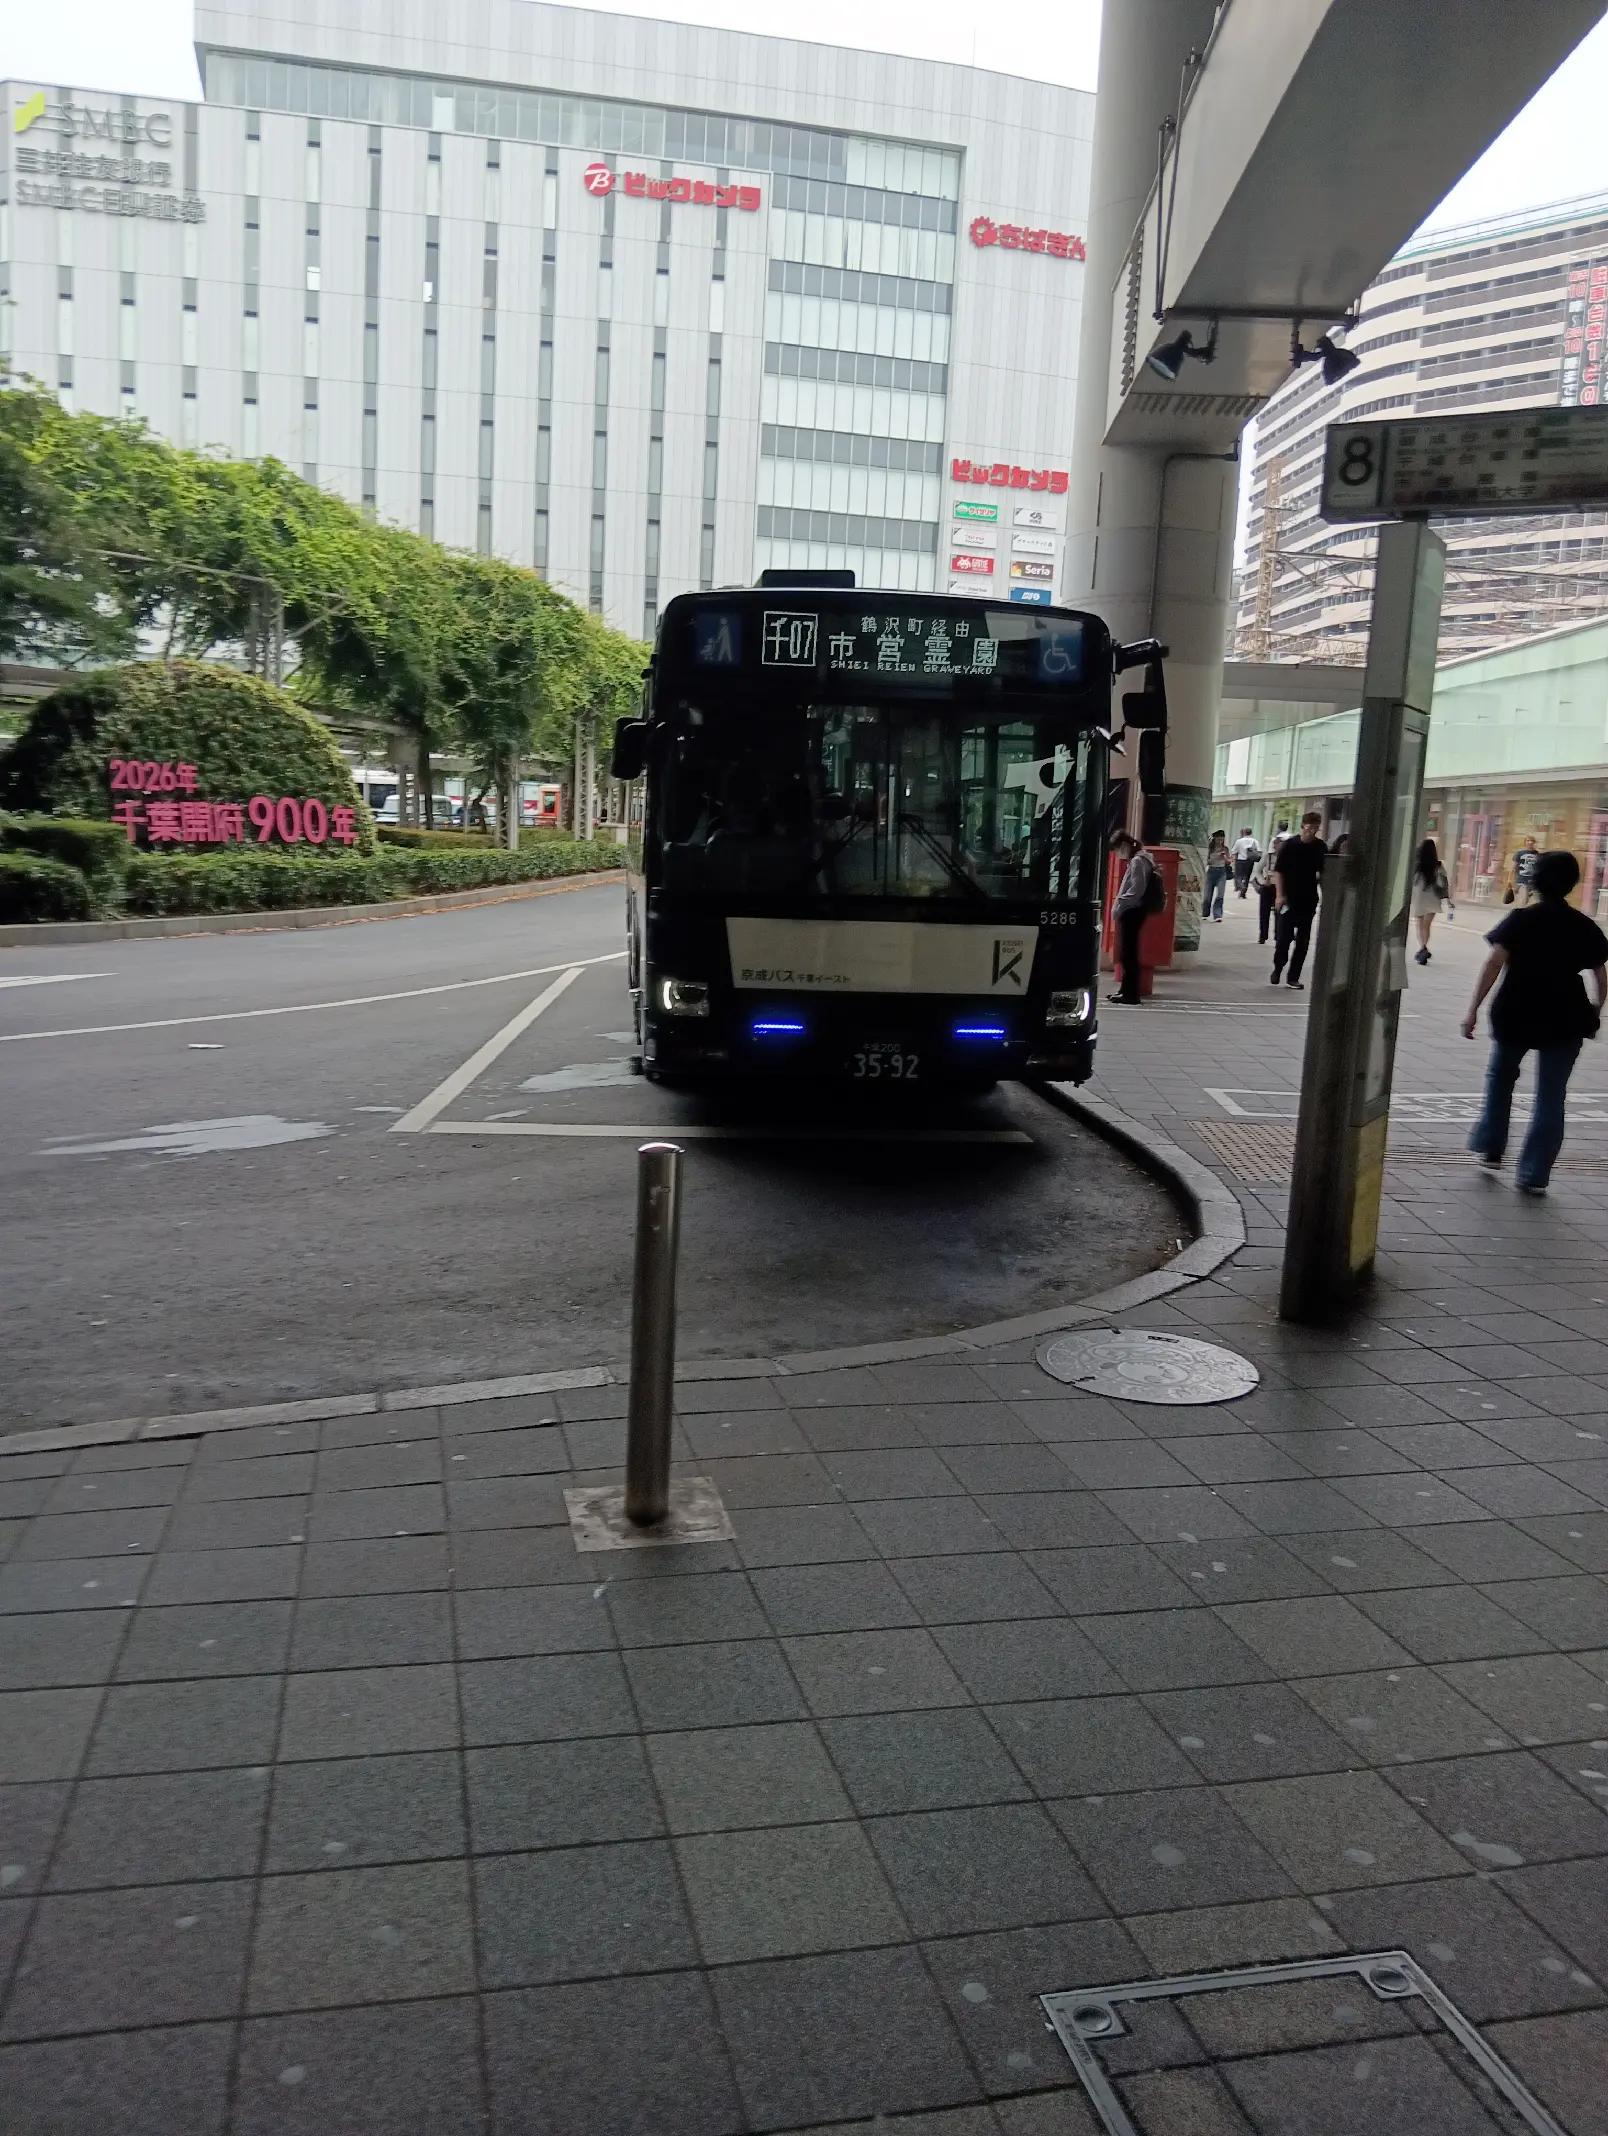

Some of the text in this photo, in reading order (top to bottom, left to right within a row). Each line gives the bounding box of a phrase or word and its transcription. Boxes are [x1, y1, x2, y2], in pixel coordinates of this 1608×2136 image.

[58, 102, 172, 148] SMBC
[15, 147, 171, 187] 三井住友銀行
[625, 171, 762, 213] ビックカメラ
[952, 458, 1069, 494] ビックカメラ
[1339, 436, 1374, 486] 8
[1025, 564, 1050, 576] Seria
[766, 617, 815, 661] 千07
[861, 615, 970, 643] 鶴沢町経由
[828, 631, 999, 667] 市営霊園
[830, 660, 993, 676] SHIEI REIEN GRAVEYARD
[110, 759, 198, 793] 2026年
[1040, 911, 1077, 925] 5286
[852, 1053, 921, 1079] 35-92
